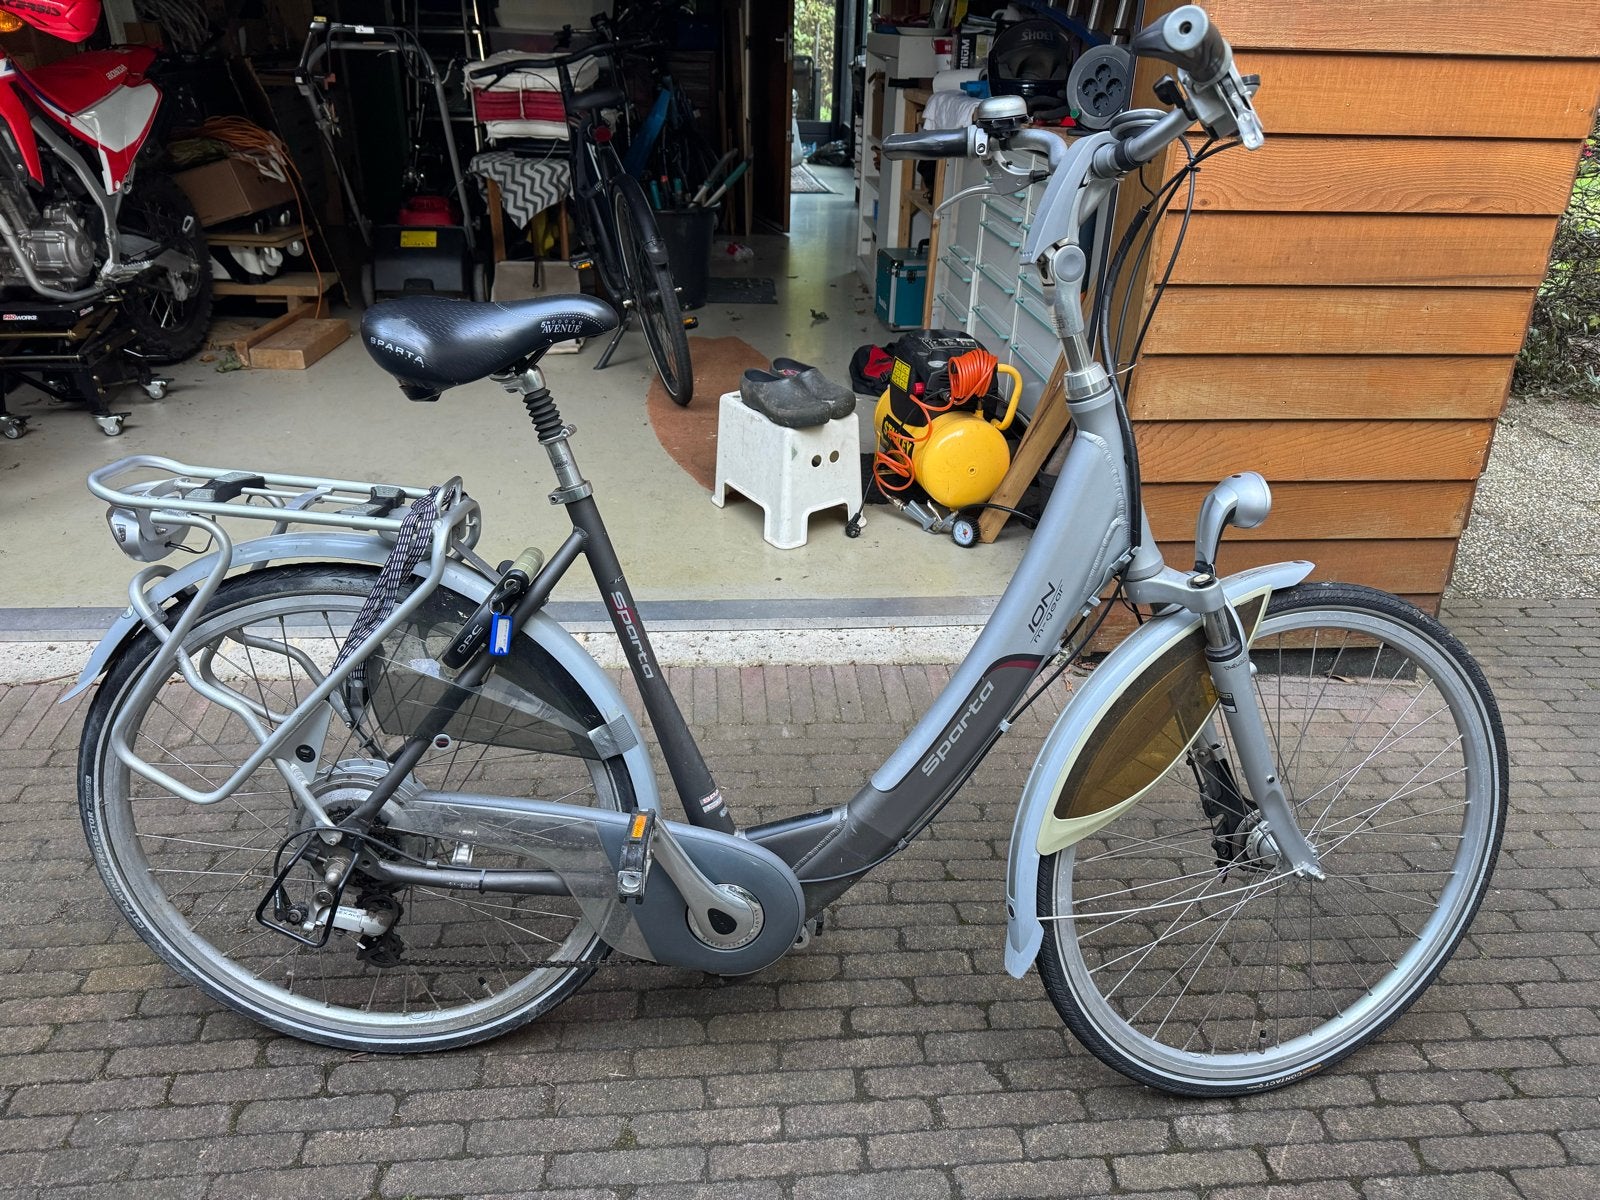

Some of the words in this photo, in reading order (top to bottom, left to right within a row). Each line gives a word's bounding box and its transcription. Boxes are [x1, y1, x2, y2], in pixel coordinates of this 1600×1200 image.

[1021, 31, 1054, 40] SHOEI
[542, 324, 582, 333] AVENUE
[370, 336, 424, 366] SPARTA
[883, 420, 913, 456] STLEY
[1028, 581, 1056, 634] ION
[1034, 584, 1063, 643] m-gear
[457, 624, 483, 654] DPC
[86, 811, 108, 867] PROTECTOR
[104, 865, 134, 914] PLATINUM
[1265, 1072, 1303, 1087] CONTACT
